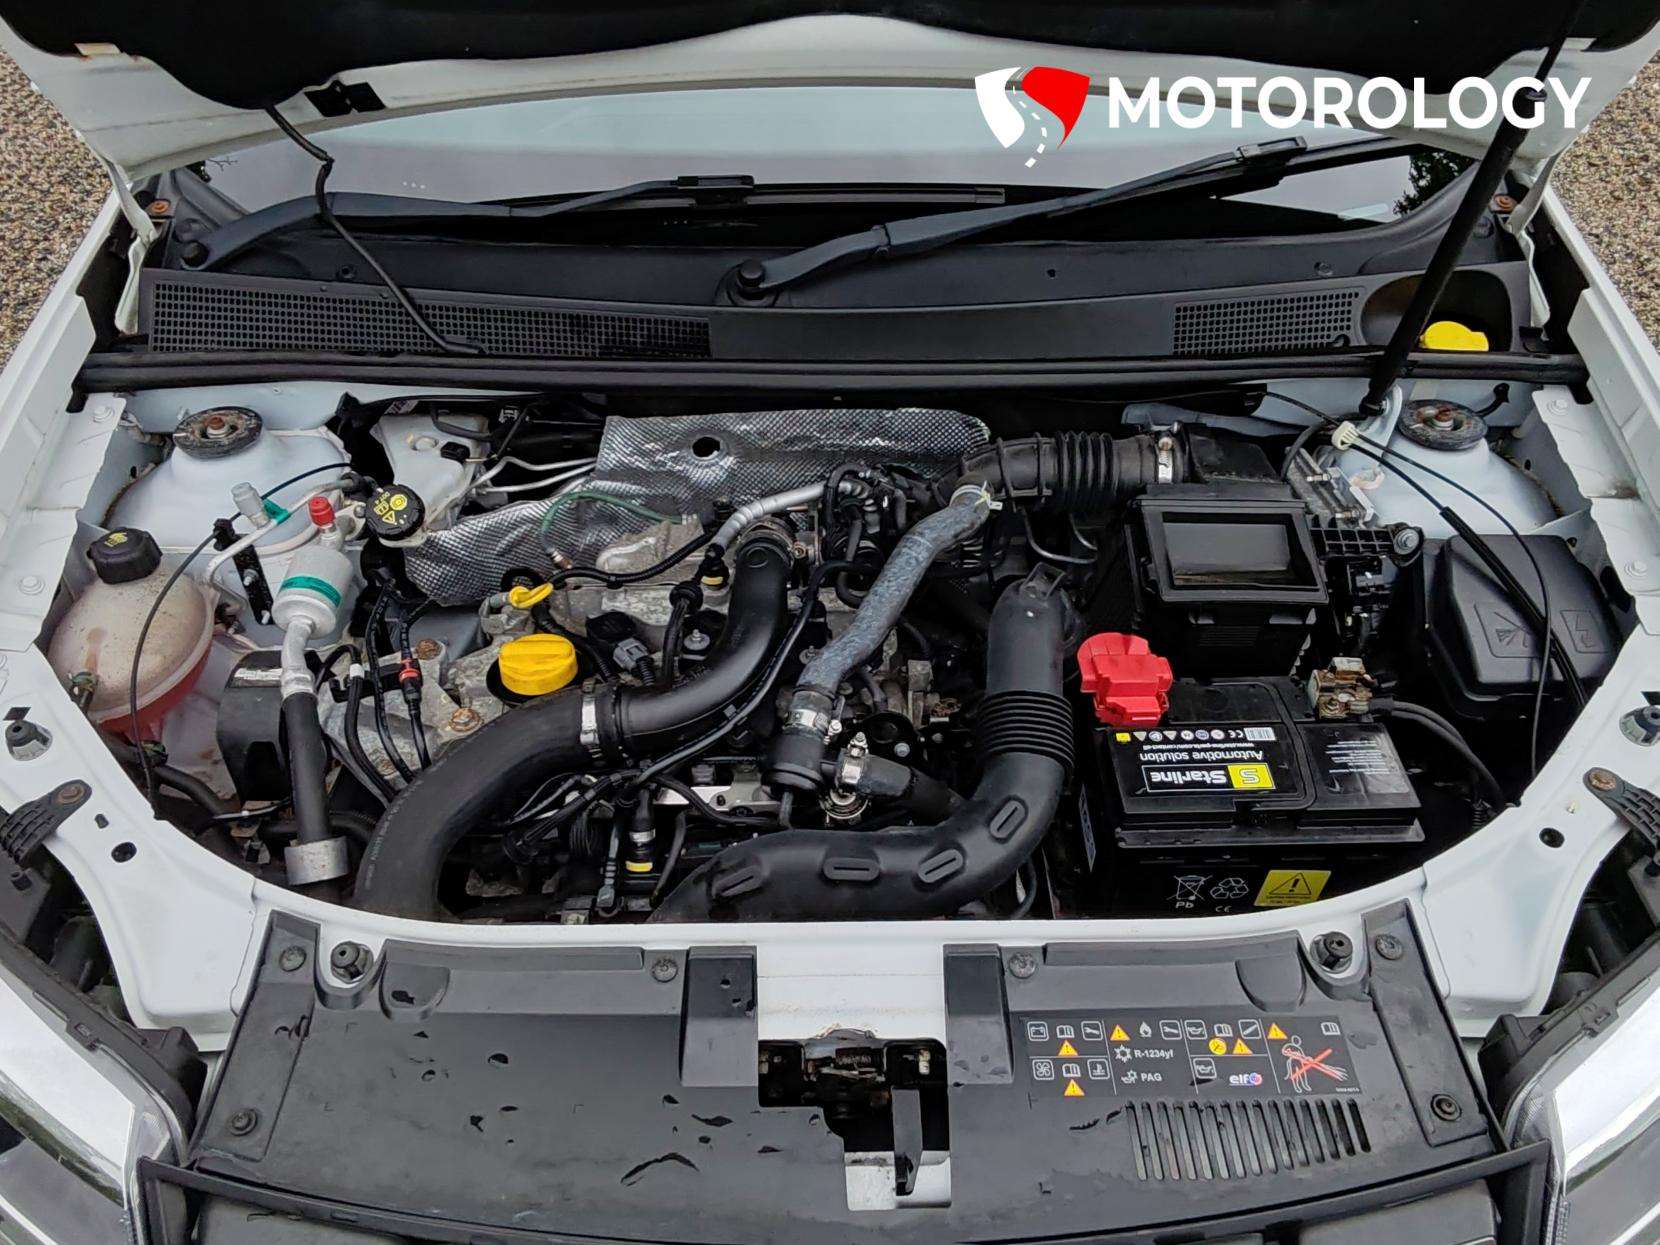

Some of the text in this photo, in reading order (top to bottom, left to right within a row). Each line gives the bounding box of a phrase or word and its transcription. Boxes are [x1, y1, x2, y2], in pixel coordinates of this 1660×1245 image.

[1139, 750, 1263, 763] Automotive solution
[1150, 769, 1228, 785] Starline
[1175, 901, 1194, 909] Pb
[1133, 1049, 1174, 1060] R-1234yf
[1141, 1073, 1162, 1082] PAG
[1229, 1073, 1249, 1084] elf
